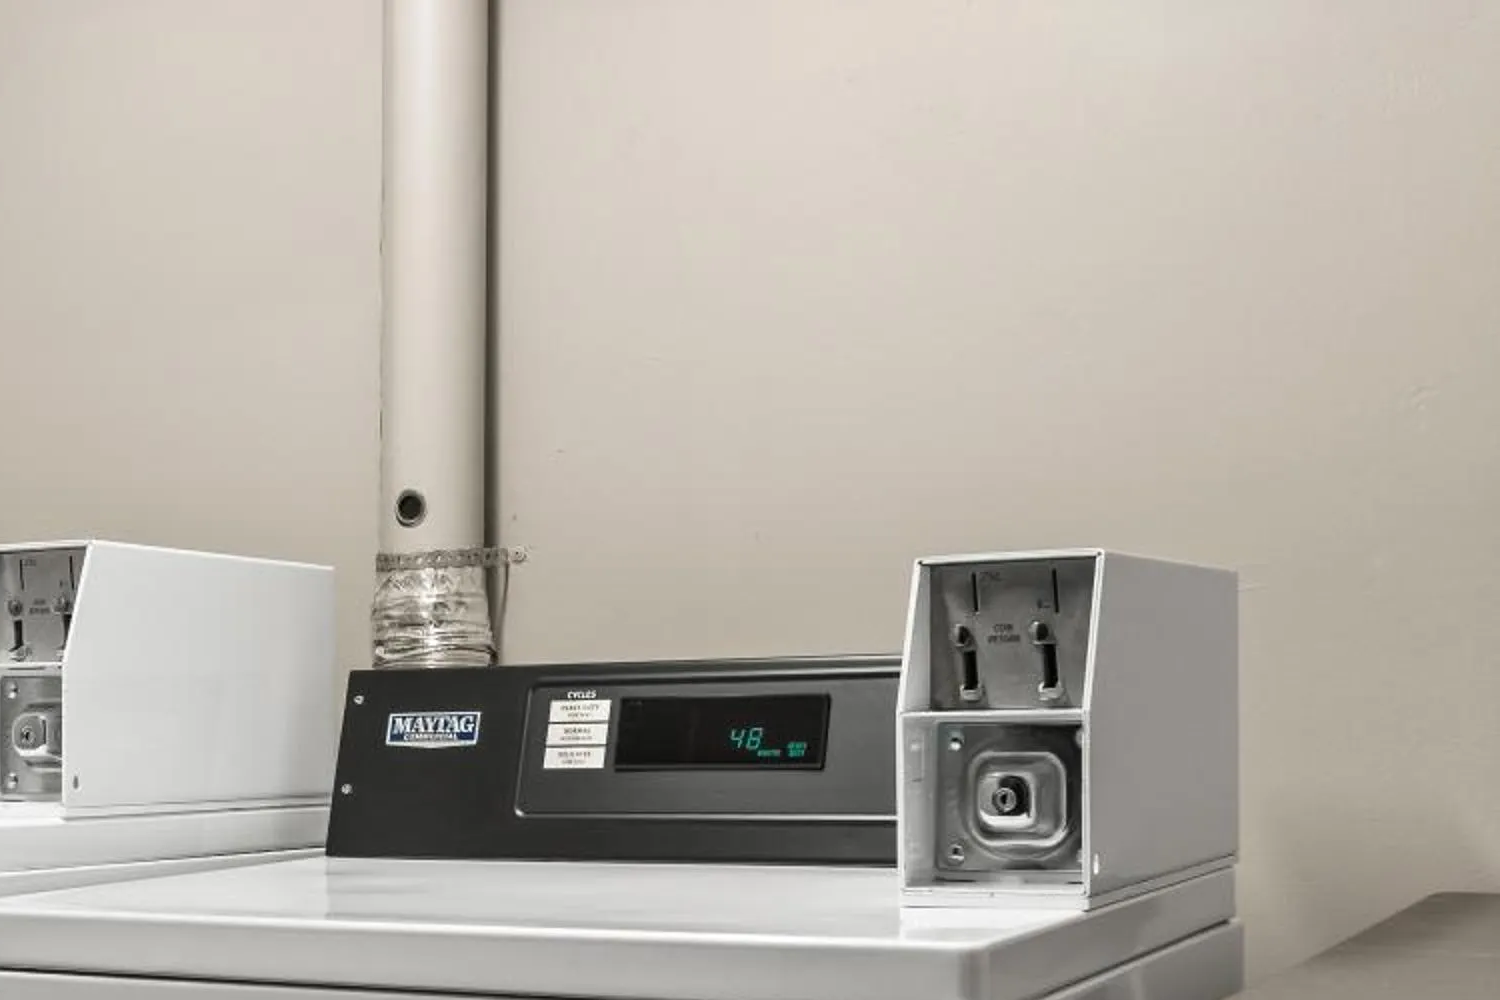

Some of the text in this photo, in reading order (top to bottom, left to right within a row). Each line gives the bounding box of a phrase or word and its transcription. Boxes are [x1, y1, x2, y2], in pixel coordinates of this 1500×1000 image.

[567, 690, 597, 699] CYCLES
[392, 716, 475, 734] MAYTAG
[730, 727, 763, 750] 48
